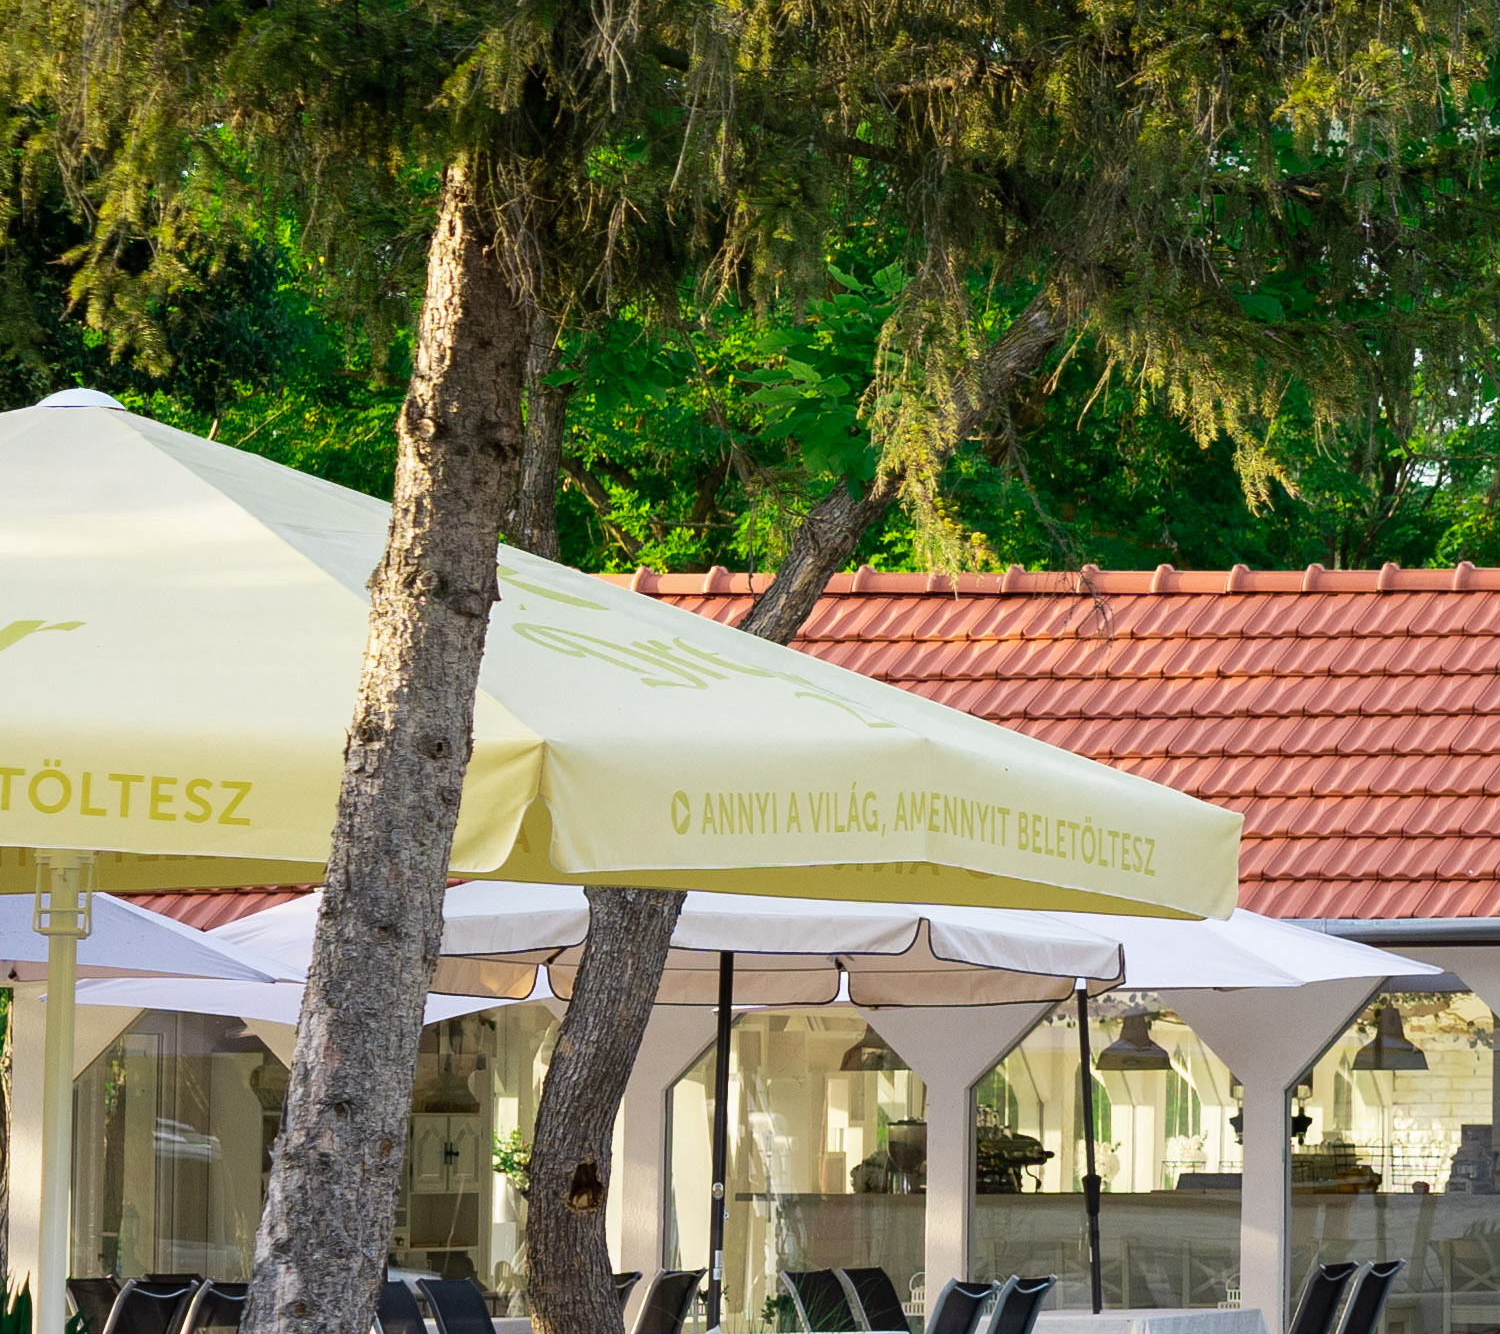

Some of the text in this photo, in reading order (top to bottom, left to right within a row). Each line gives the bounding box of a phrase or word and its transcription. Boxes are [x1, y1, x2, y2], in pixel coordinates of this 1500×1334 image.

[701, 791, 778, 835] ANNYI
[786, 791, 802, 834] A
[808, 781, 886, 837] VILÁG,
[894, 791, 1010, 848] AMENNYIT
[1017, 816, 1157, 877] BELETÖLTESZ
